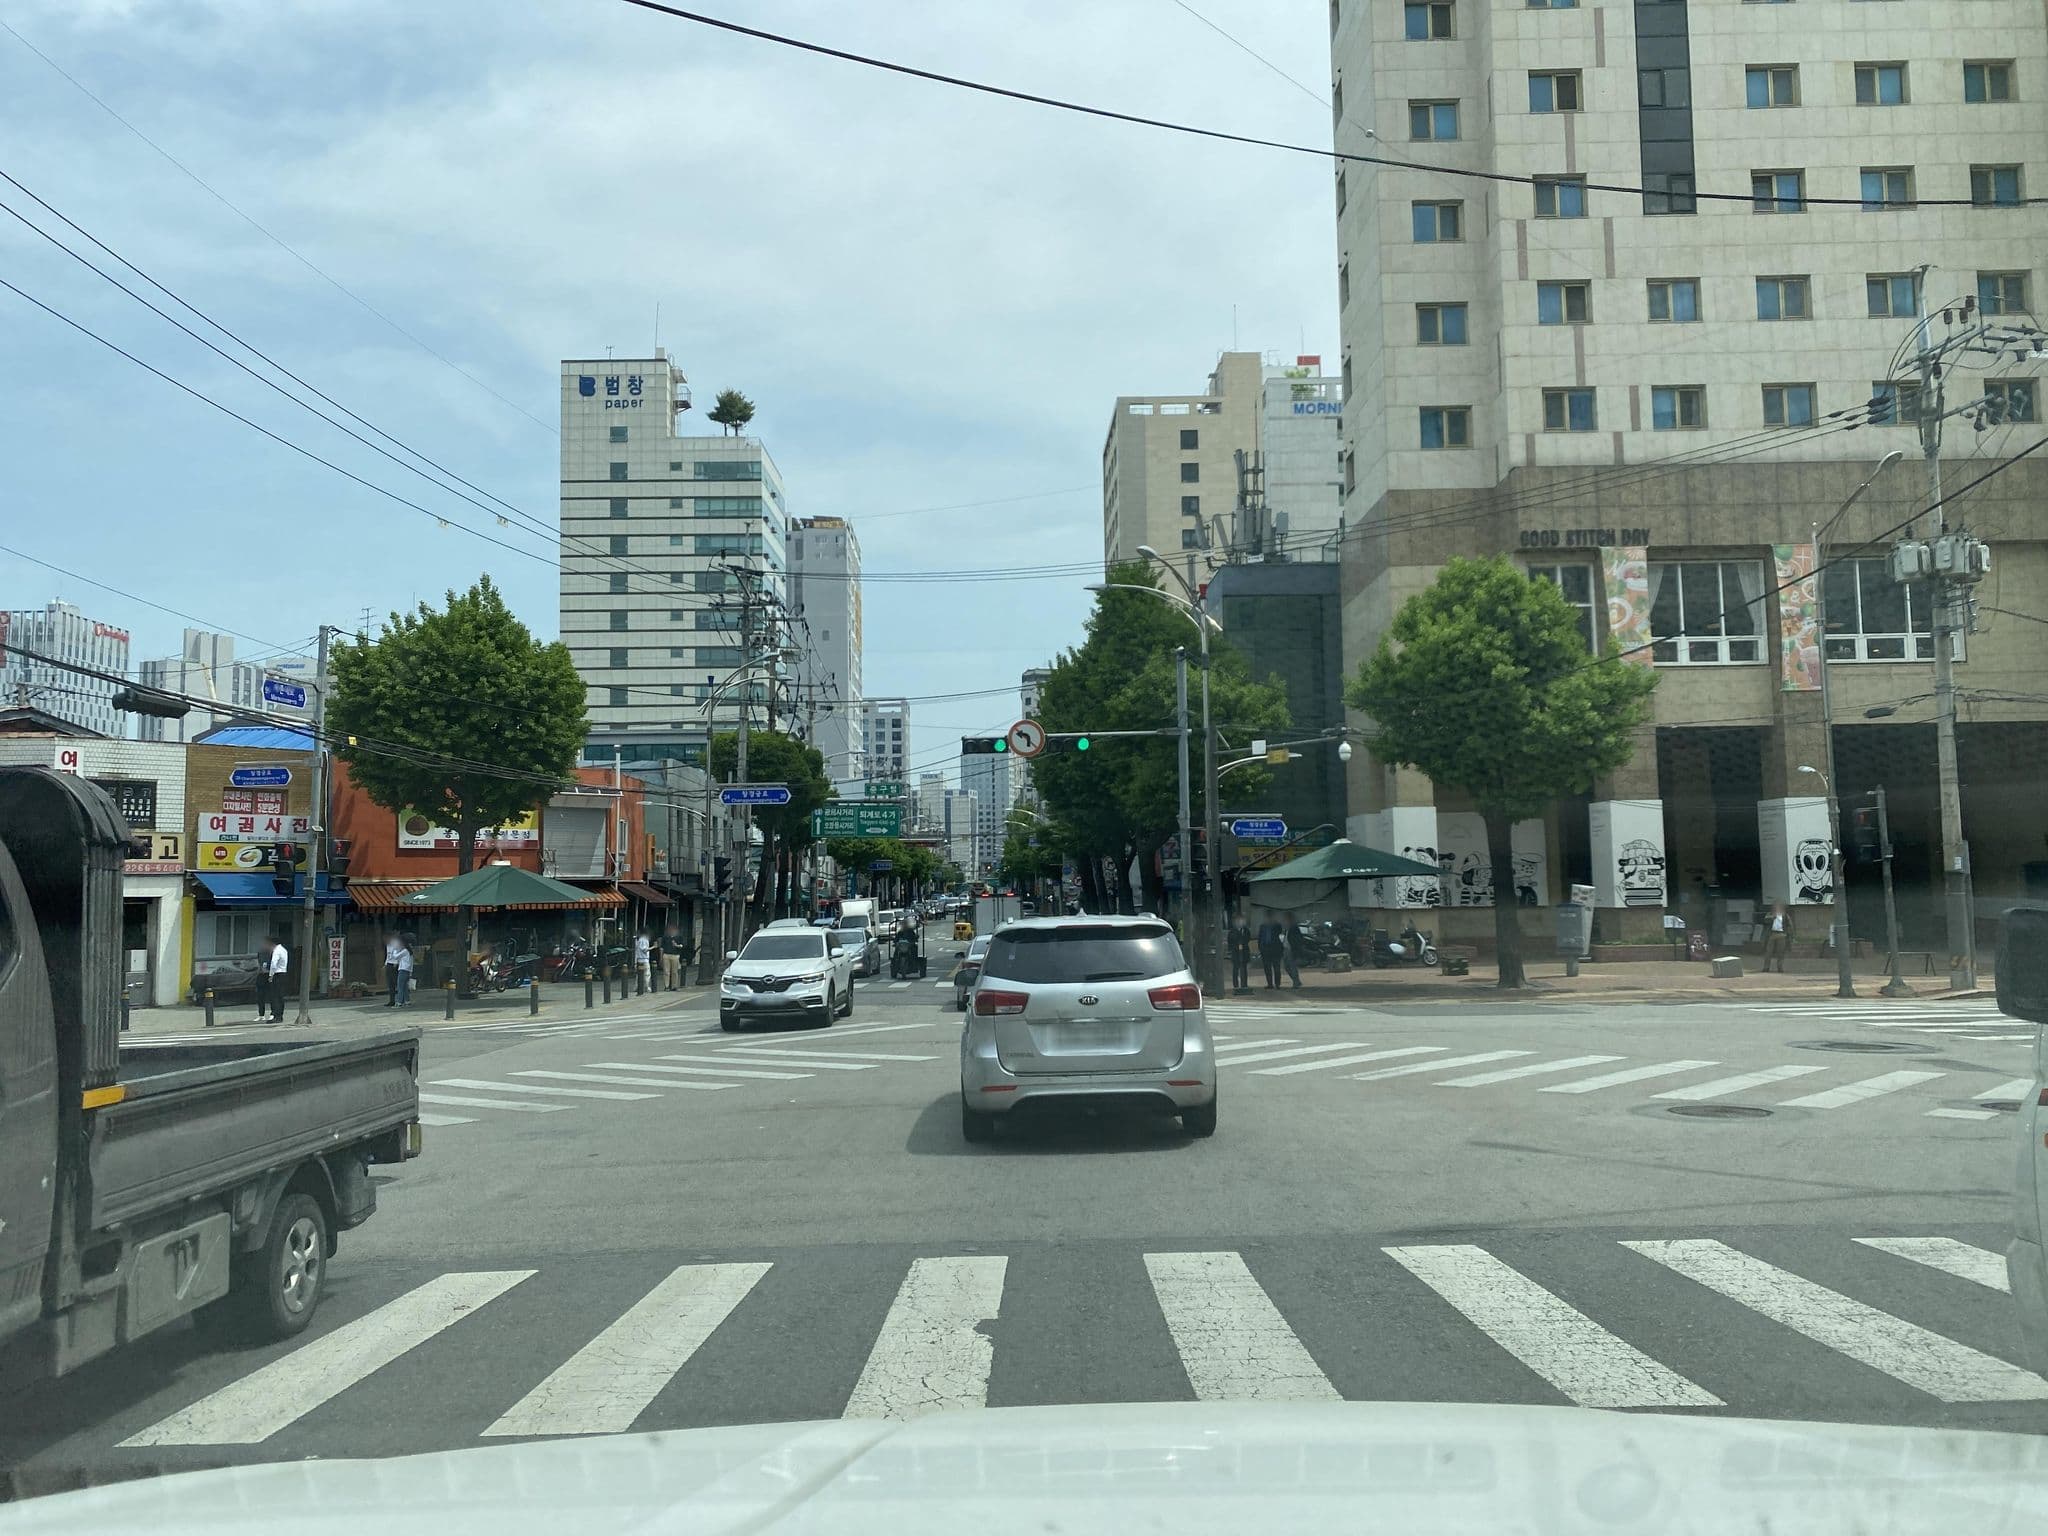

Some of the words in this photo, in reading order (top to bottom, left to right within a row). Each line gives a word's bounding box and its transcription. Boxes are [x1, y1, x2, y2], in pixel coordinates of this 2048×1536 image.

[605, 375, 643, 396] 범창
[605, 399, 644, 410] paper
[1519, 529, 1560, 547] GOOD
[1566, 528, 1617, 547] STITCH
[869, 785, 897, 794] 중구청
[210, 816, 308, 834] 여권사진
